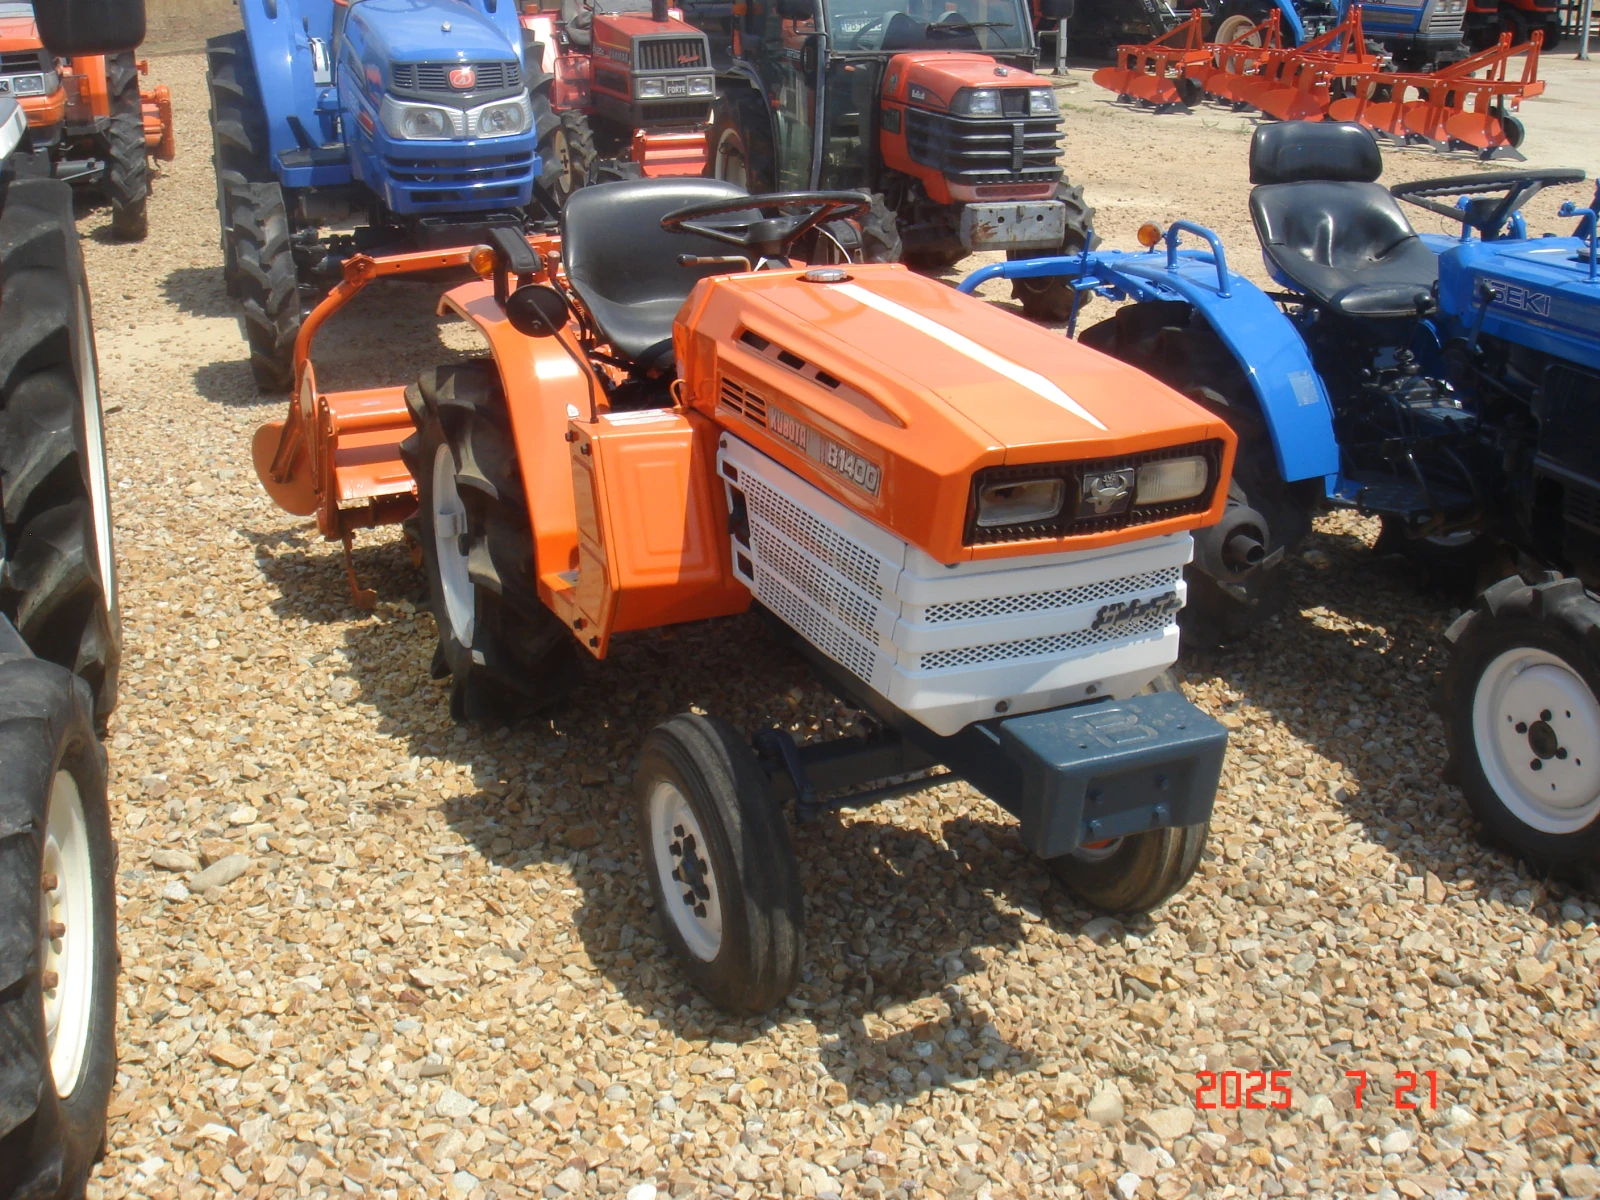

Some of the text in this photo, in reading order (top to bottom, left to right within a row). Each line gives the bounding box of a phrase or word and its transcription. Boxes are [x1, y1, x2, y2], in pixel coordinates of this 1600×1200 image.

[667, 85, 686, 94] FORTE
[1482, 278, 1551, 317] SEKI
[769, 407, 879, 492] KUBOTA B1400
